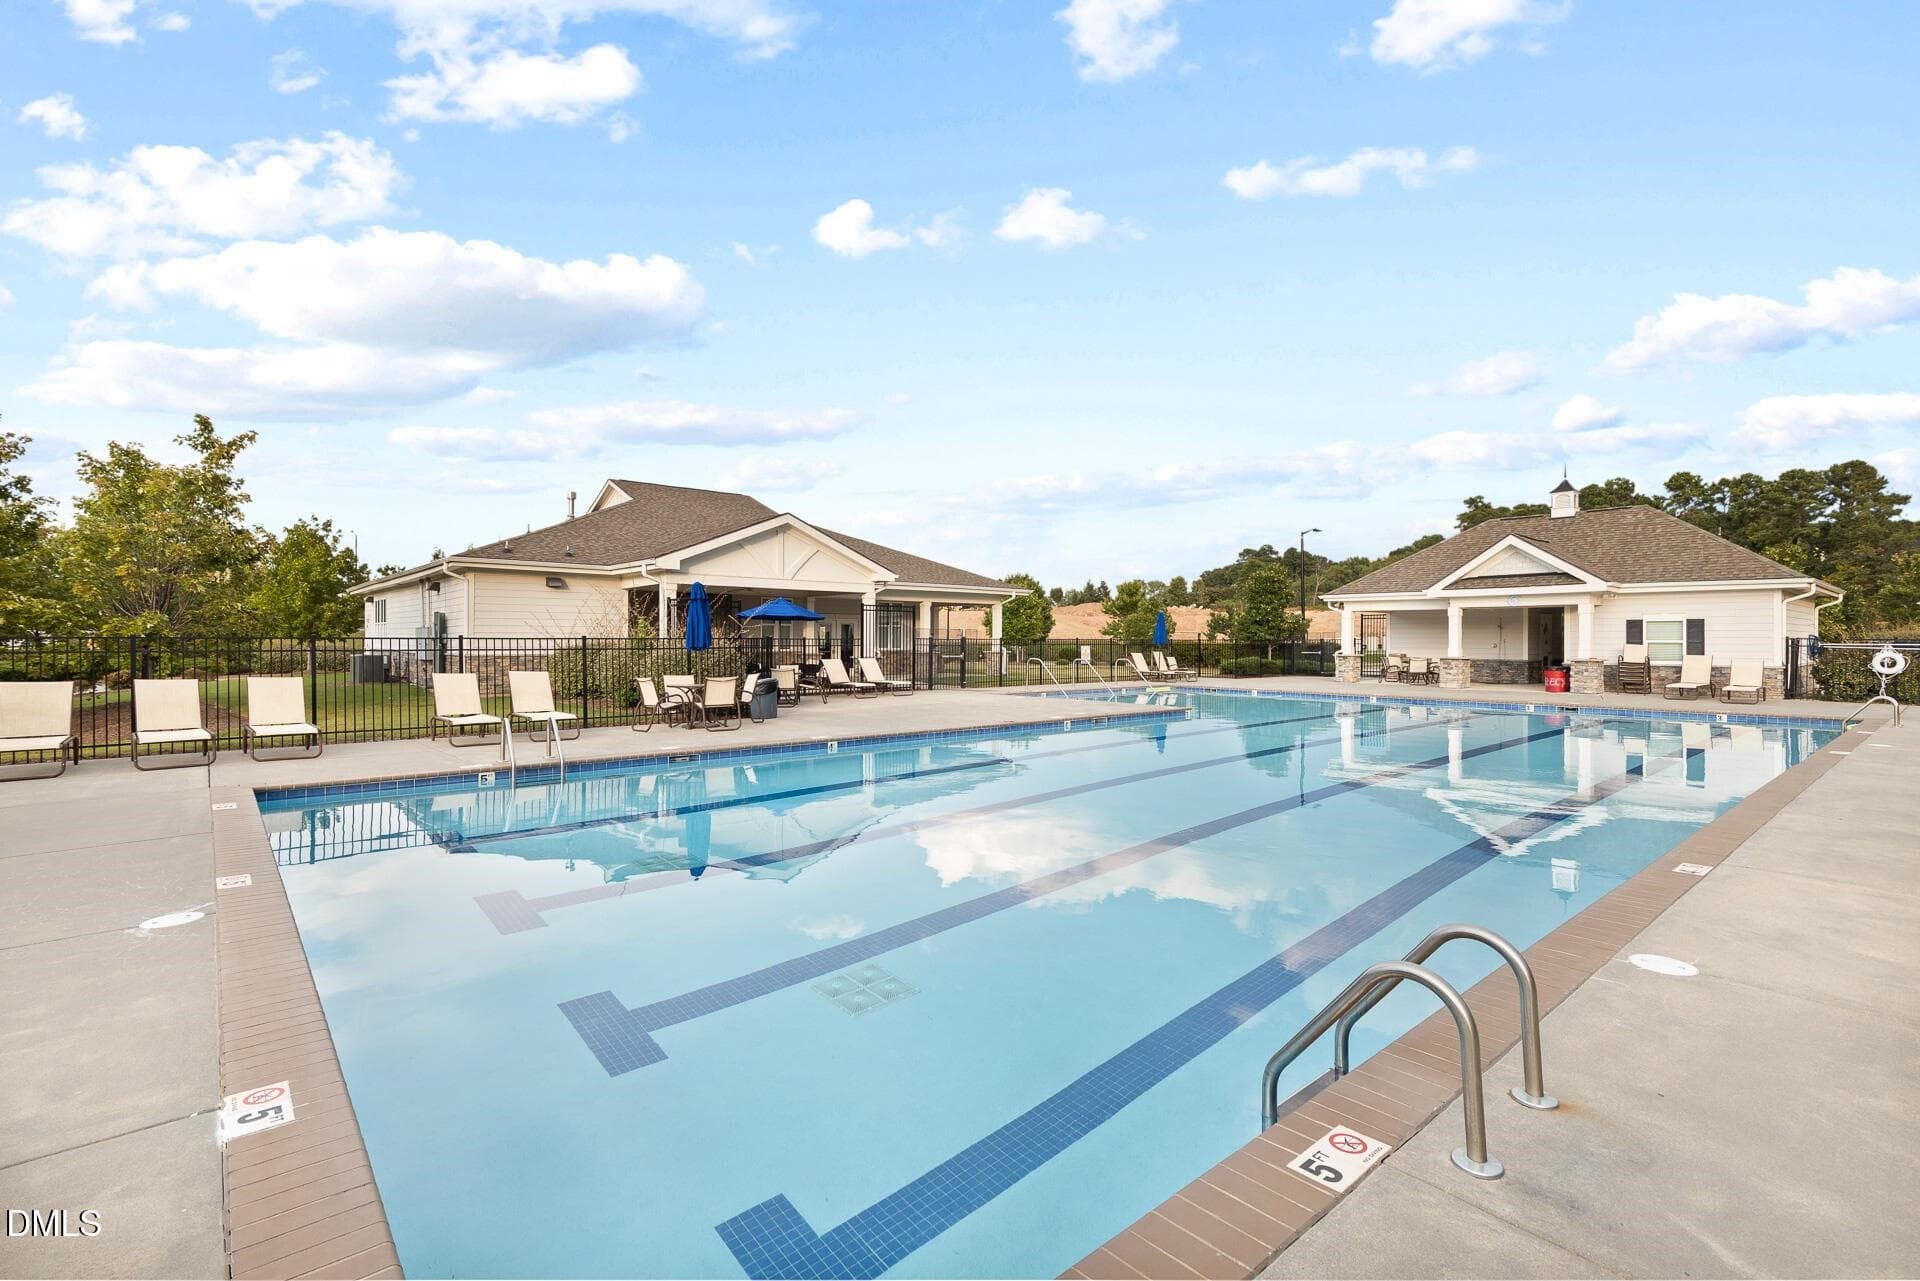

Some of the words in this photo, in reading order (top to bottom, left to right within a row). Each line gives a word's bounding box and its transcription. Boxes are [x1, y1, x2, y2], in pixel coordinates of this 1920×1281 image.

[237, 1105, 283, 1125] 5
[1311, 1150, 1330, 1162] FT
[1299, 1158, 1344, 1183] 5
